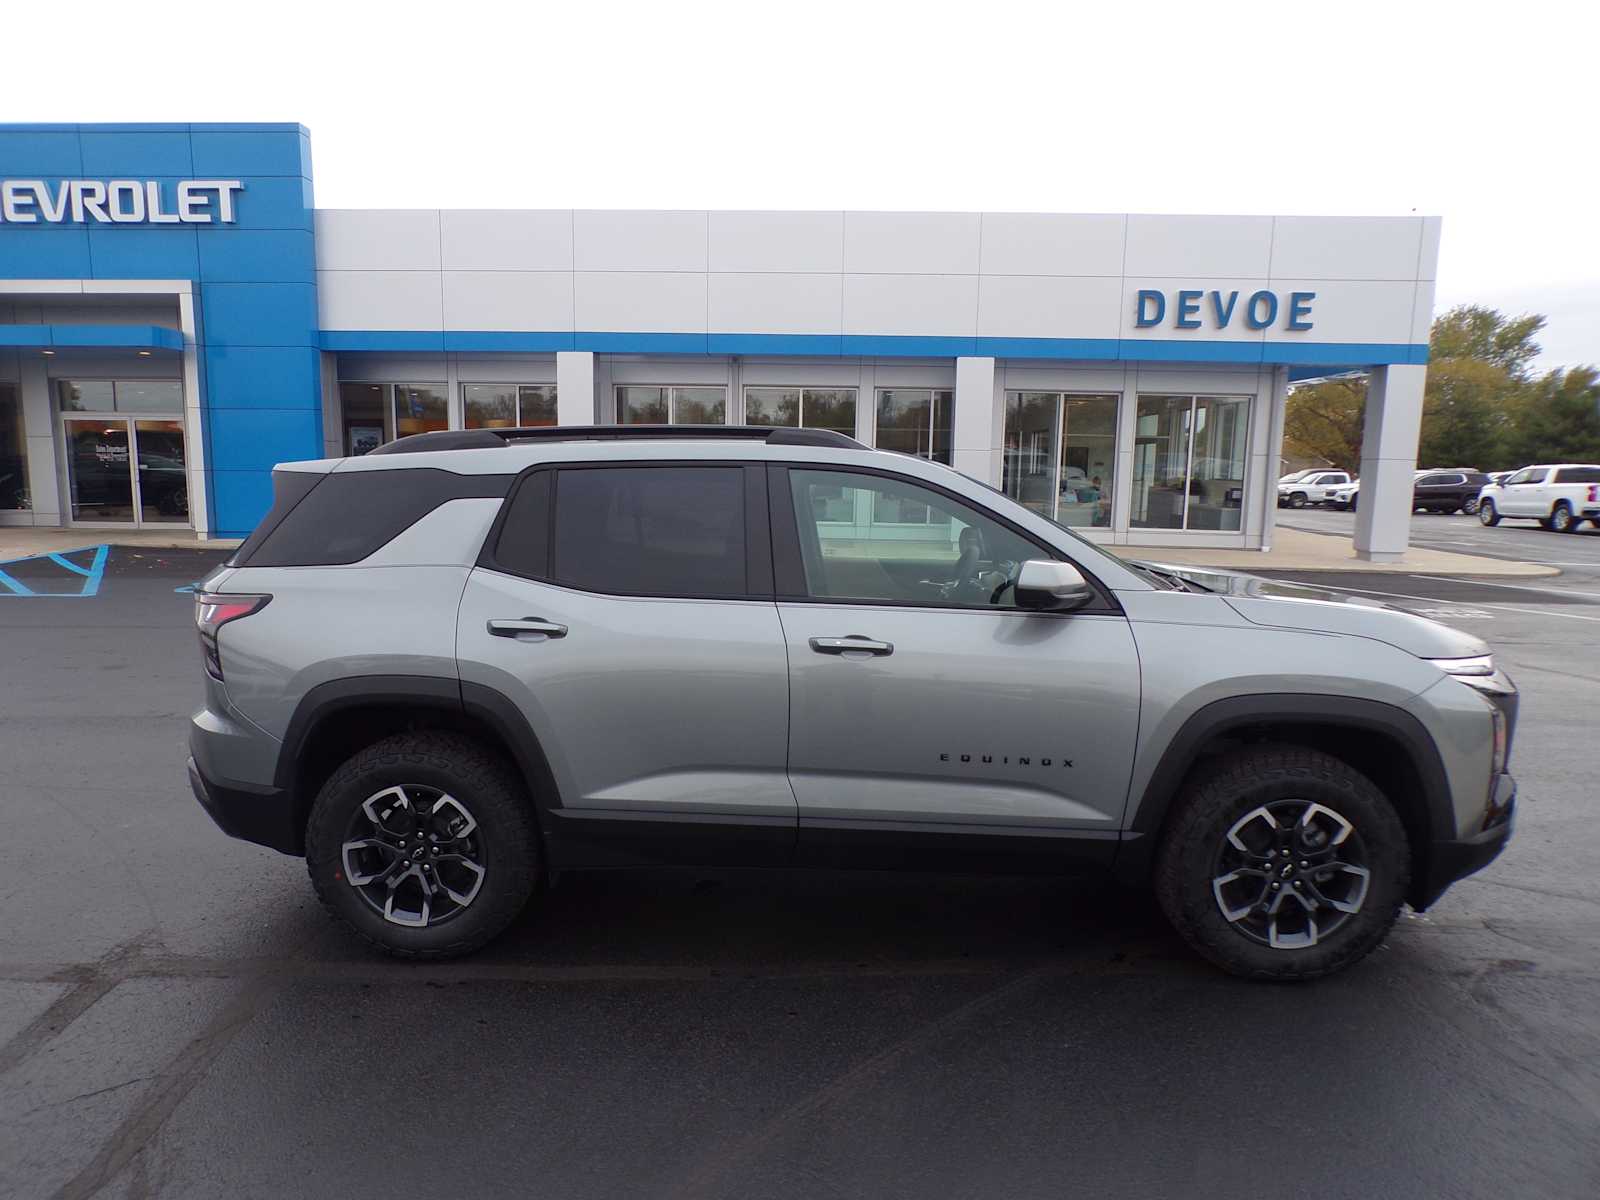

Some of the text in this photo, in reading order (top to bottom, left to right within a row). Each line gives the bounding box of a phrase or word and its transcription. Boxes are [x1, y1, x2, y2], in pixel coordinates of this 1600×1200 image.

[0, 180, 242, 224] EVROLET
[1135, 289, 1316, 331] DEVOE
[940, 753, 1073, 768] EQUINOX
